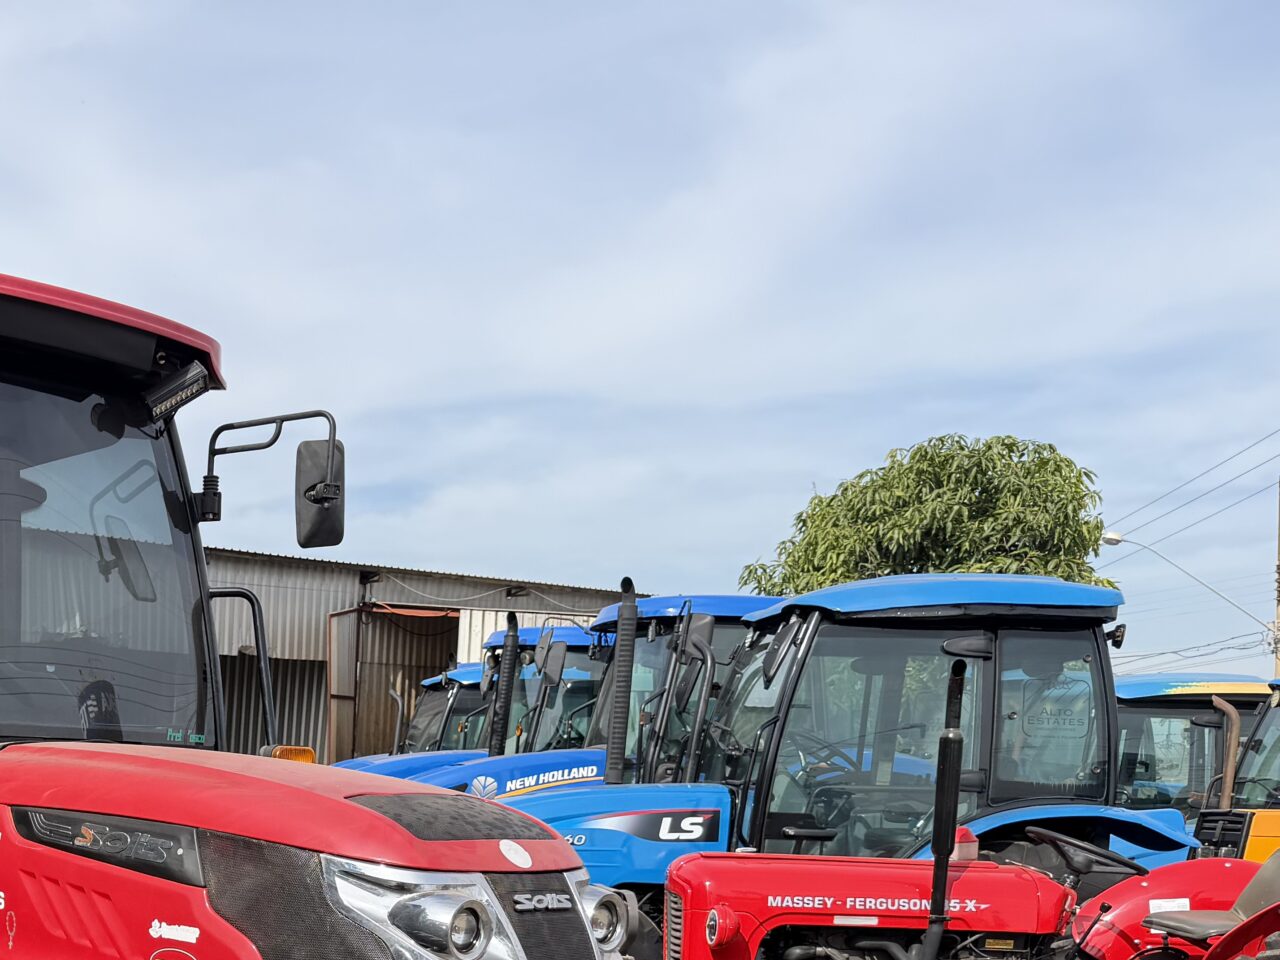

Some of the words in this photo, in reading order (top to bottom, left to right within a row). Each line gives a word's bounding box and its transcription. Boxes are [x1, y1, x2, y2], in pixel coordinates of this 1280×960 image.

[1040, 706, 1073, 717] ALTO
[1027, 716, 1085, 726] ESTATES
[506, 777, 537, 792] NEW
[540, 765, 598, 783] HOLLAND
[658, 816, 705, 841] LS
[767, 896, 834, 909] MASSEY
[846, 897, 932, 911] FERGUSON
[964, 899, 977, 912] X
